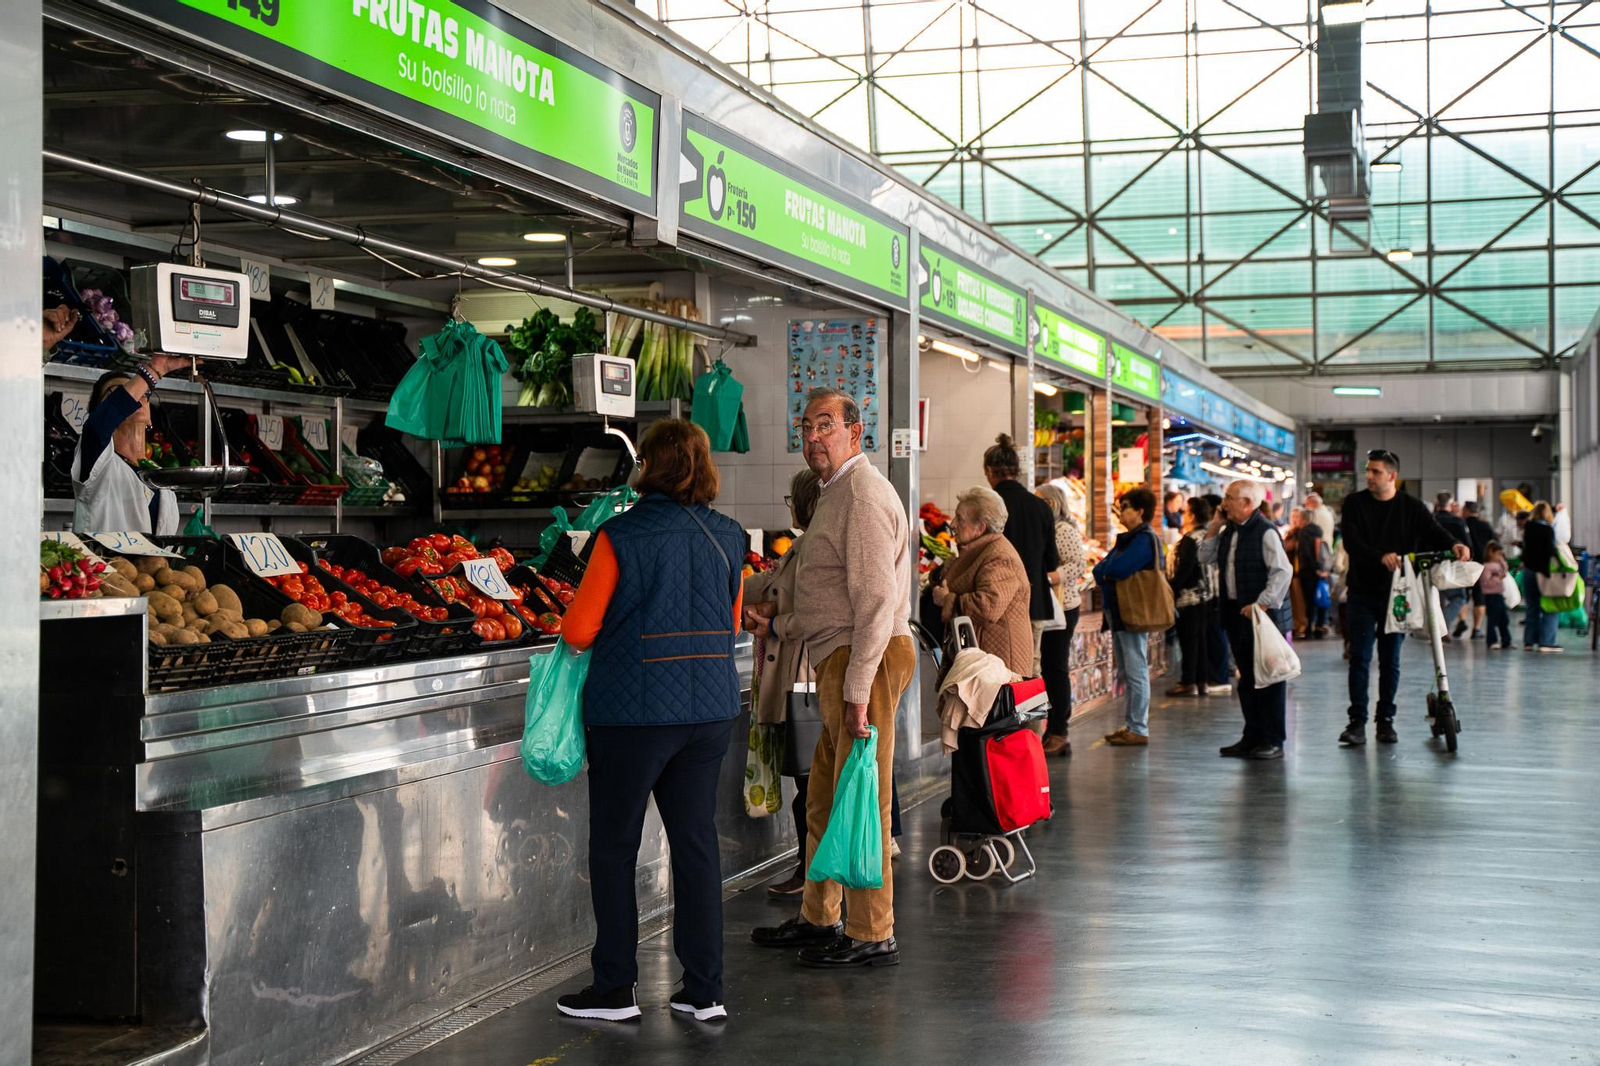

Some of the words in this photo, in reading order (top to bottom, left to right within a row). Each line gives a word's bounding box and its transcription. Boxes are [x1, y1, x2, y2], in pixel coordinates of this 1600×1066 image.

[398, 52, 417, 81] Su
[422, 61, 472, 101] bolsillo
[476, 87, 487, 110] lo
[490, 95, 516, 126] nota
[466, 27, 555, 106] MANOTA
[736, 199, 756, 230] 150
[785, 188, 825, 231] FRUTAS
[827, 210, 866, 249] MANOTA
